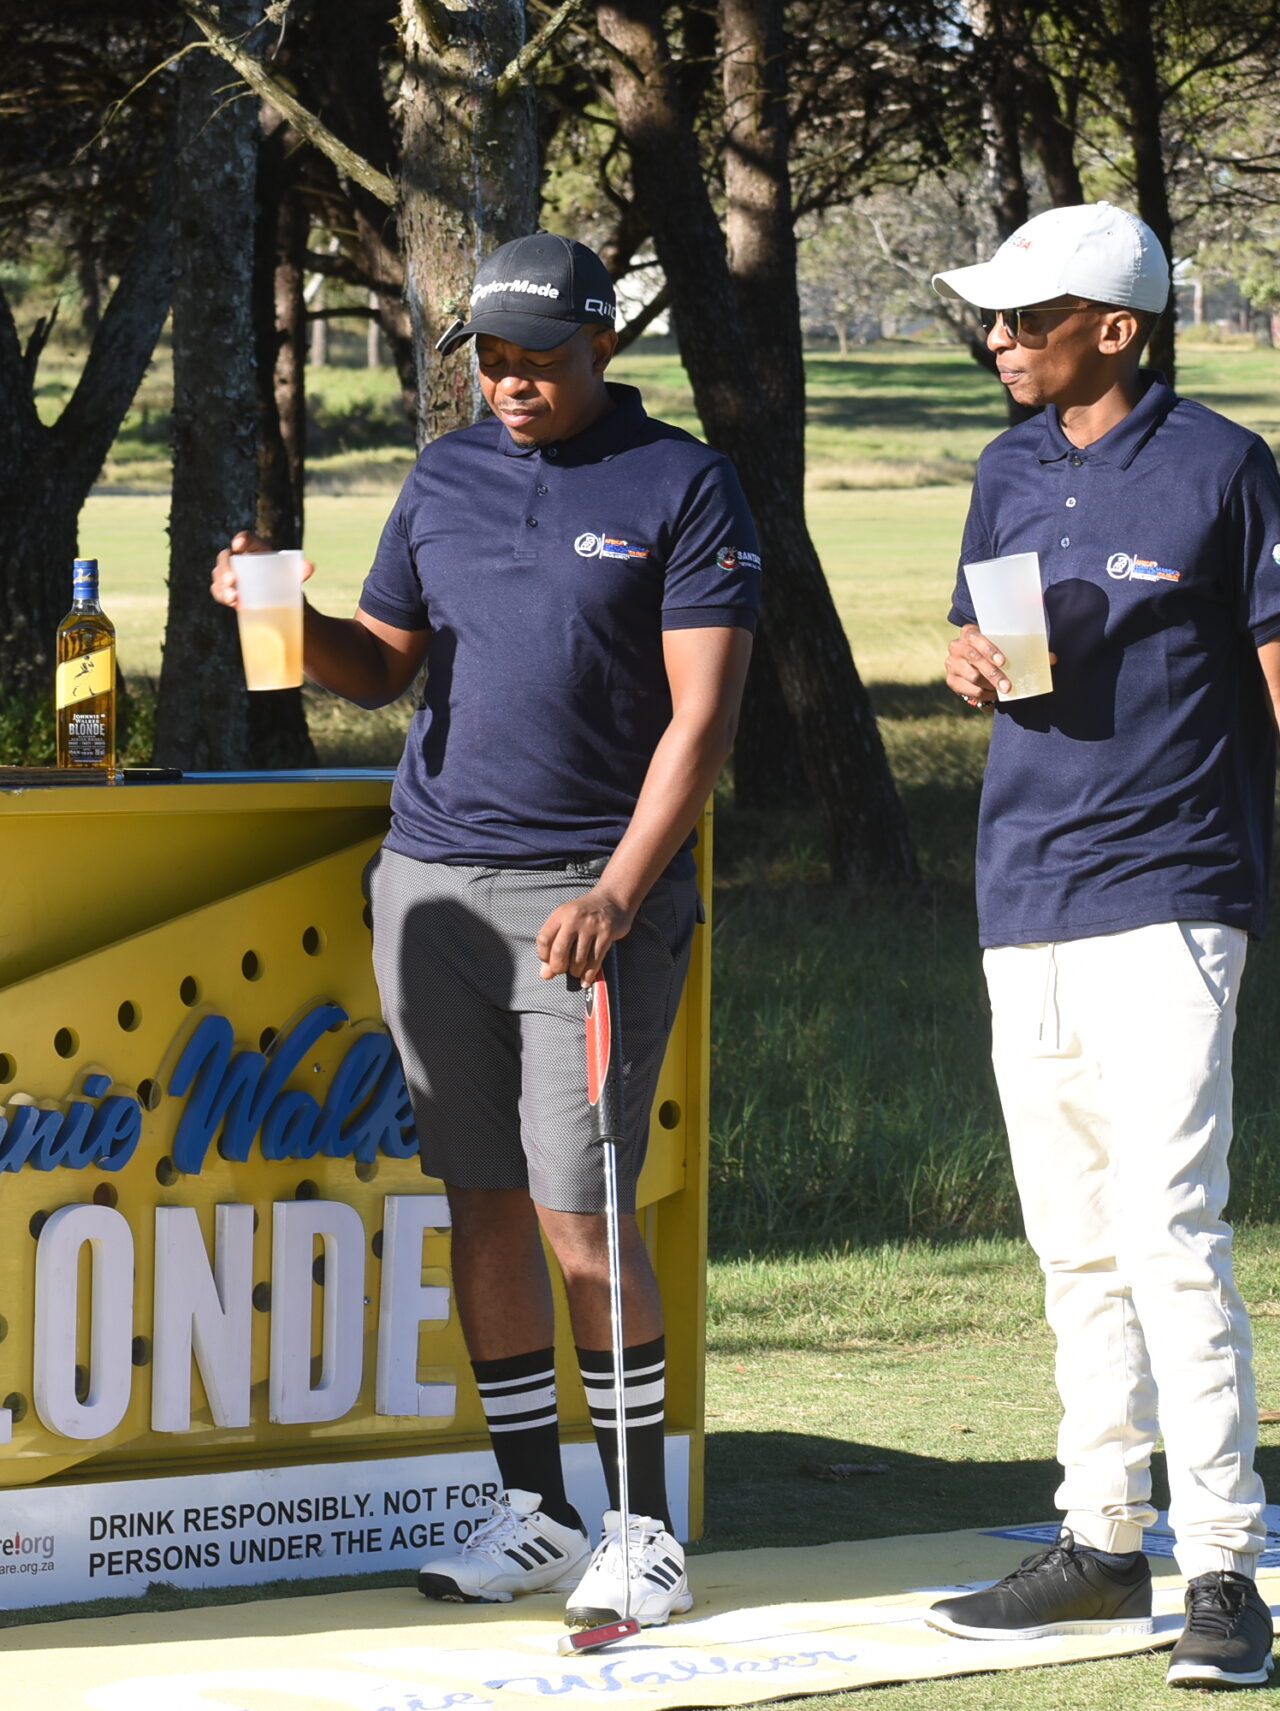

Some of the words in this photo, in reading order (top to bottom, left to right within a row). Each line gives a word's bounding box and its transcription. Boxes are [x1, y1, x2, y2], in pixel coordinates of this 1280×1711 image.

[68, 723, 106, 736] BLONDE
[168, 1004, 420, 1175] Walk
[89, 1509, 176, 1541] DRINK
[183, 1493, 374, 1533] RESPONSIBLY.
[384, 1487, 438, 1516] NOT
[446, 1482, 499, 1510] FOR
[89, 1542, 221, 1577] PERSONS
[229, 1533, 323, 1565] UNDER
[331, 1528, 383, 1556] THE
[389, 1522, 445, 1550] AGE
